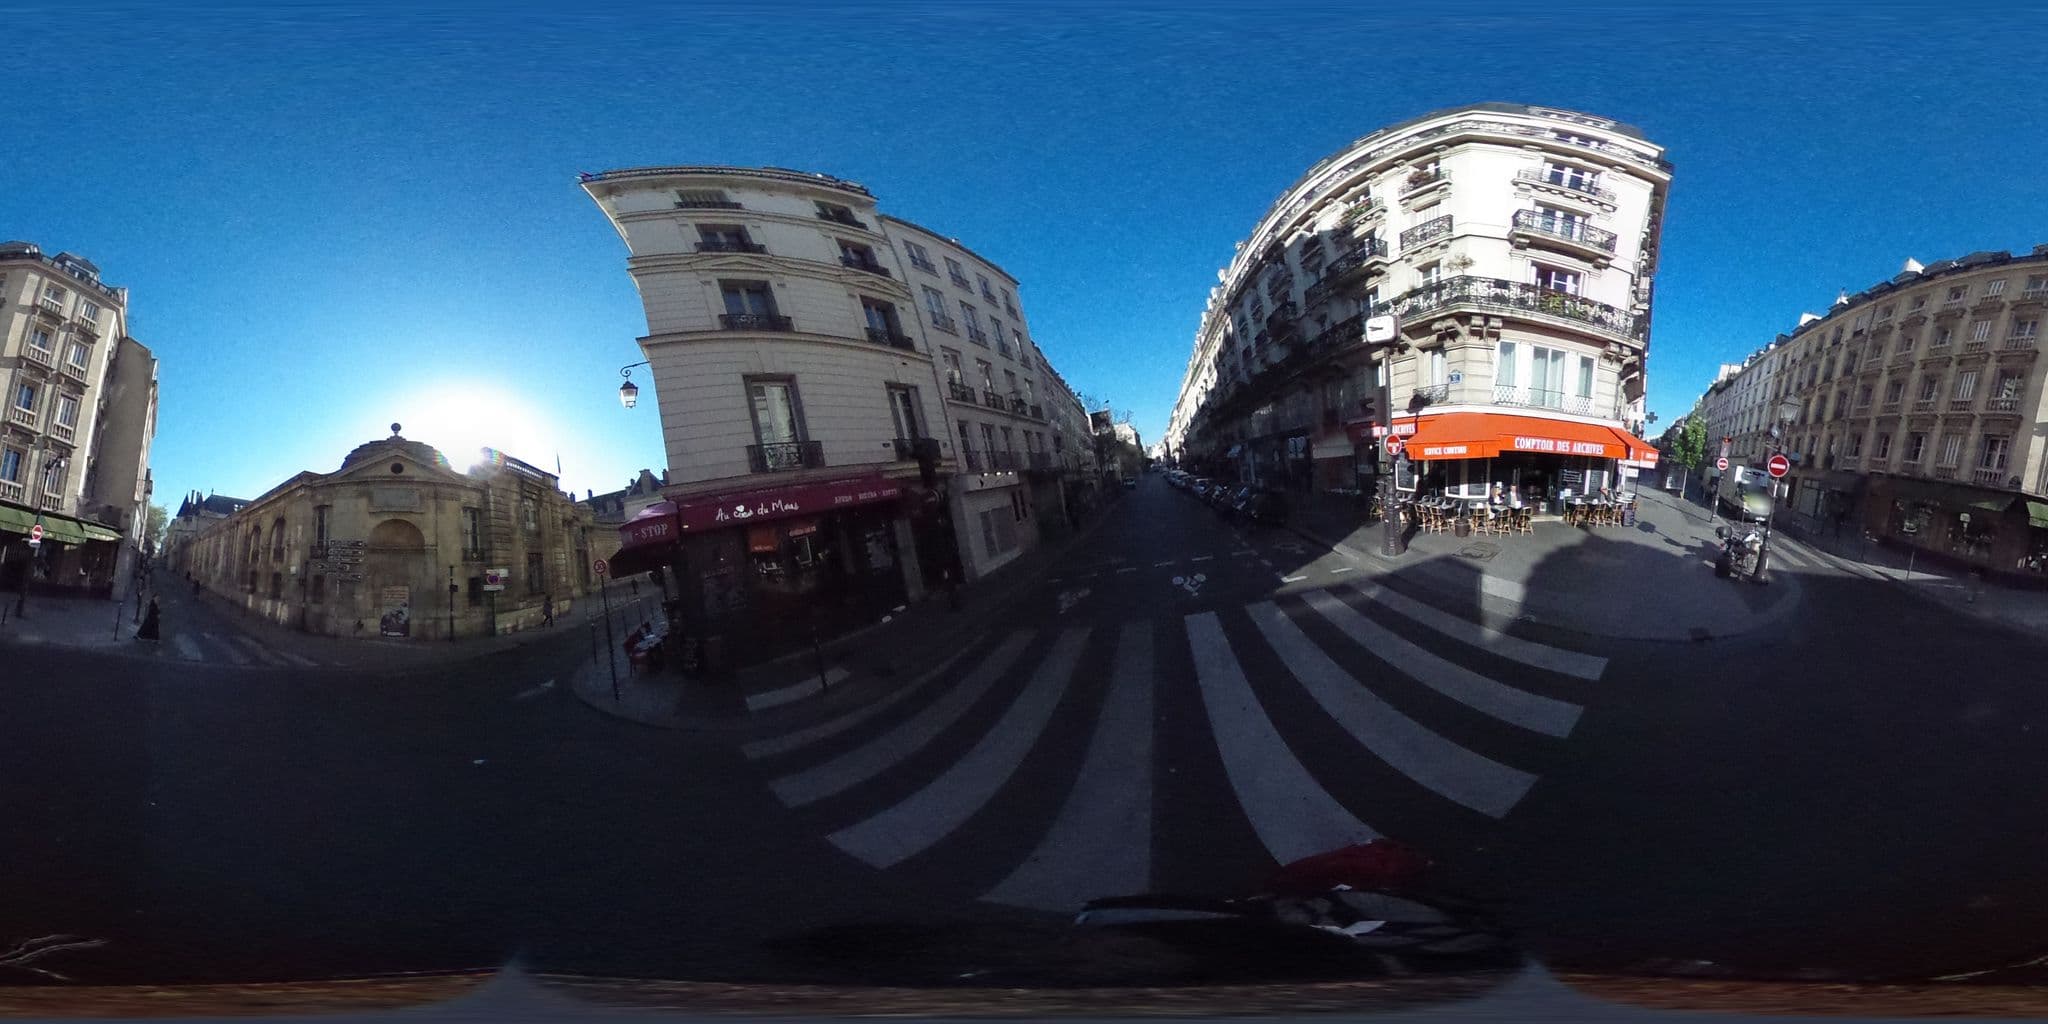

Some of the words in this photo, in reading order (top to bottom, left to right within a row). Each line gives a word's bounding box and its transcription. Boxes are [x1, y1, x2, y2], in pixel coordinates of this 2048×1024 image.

[1514, 437, 1554, 451] COMPTOIR
[1557, 441, 1570, 452] DES
[1572, 442, 1604, 455] ARCHIVES
[715, 507, 731, 521] Au
[757, 502, 770, 516] du
